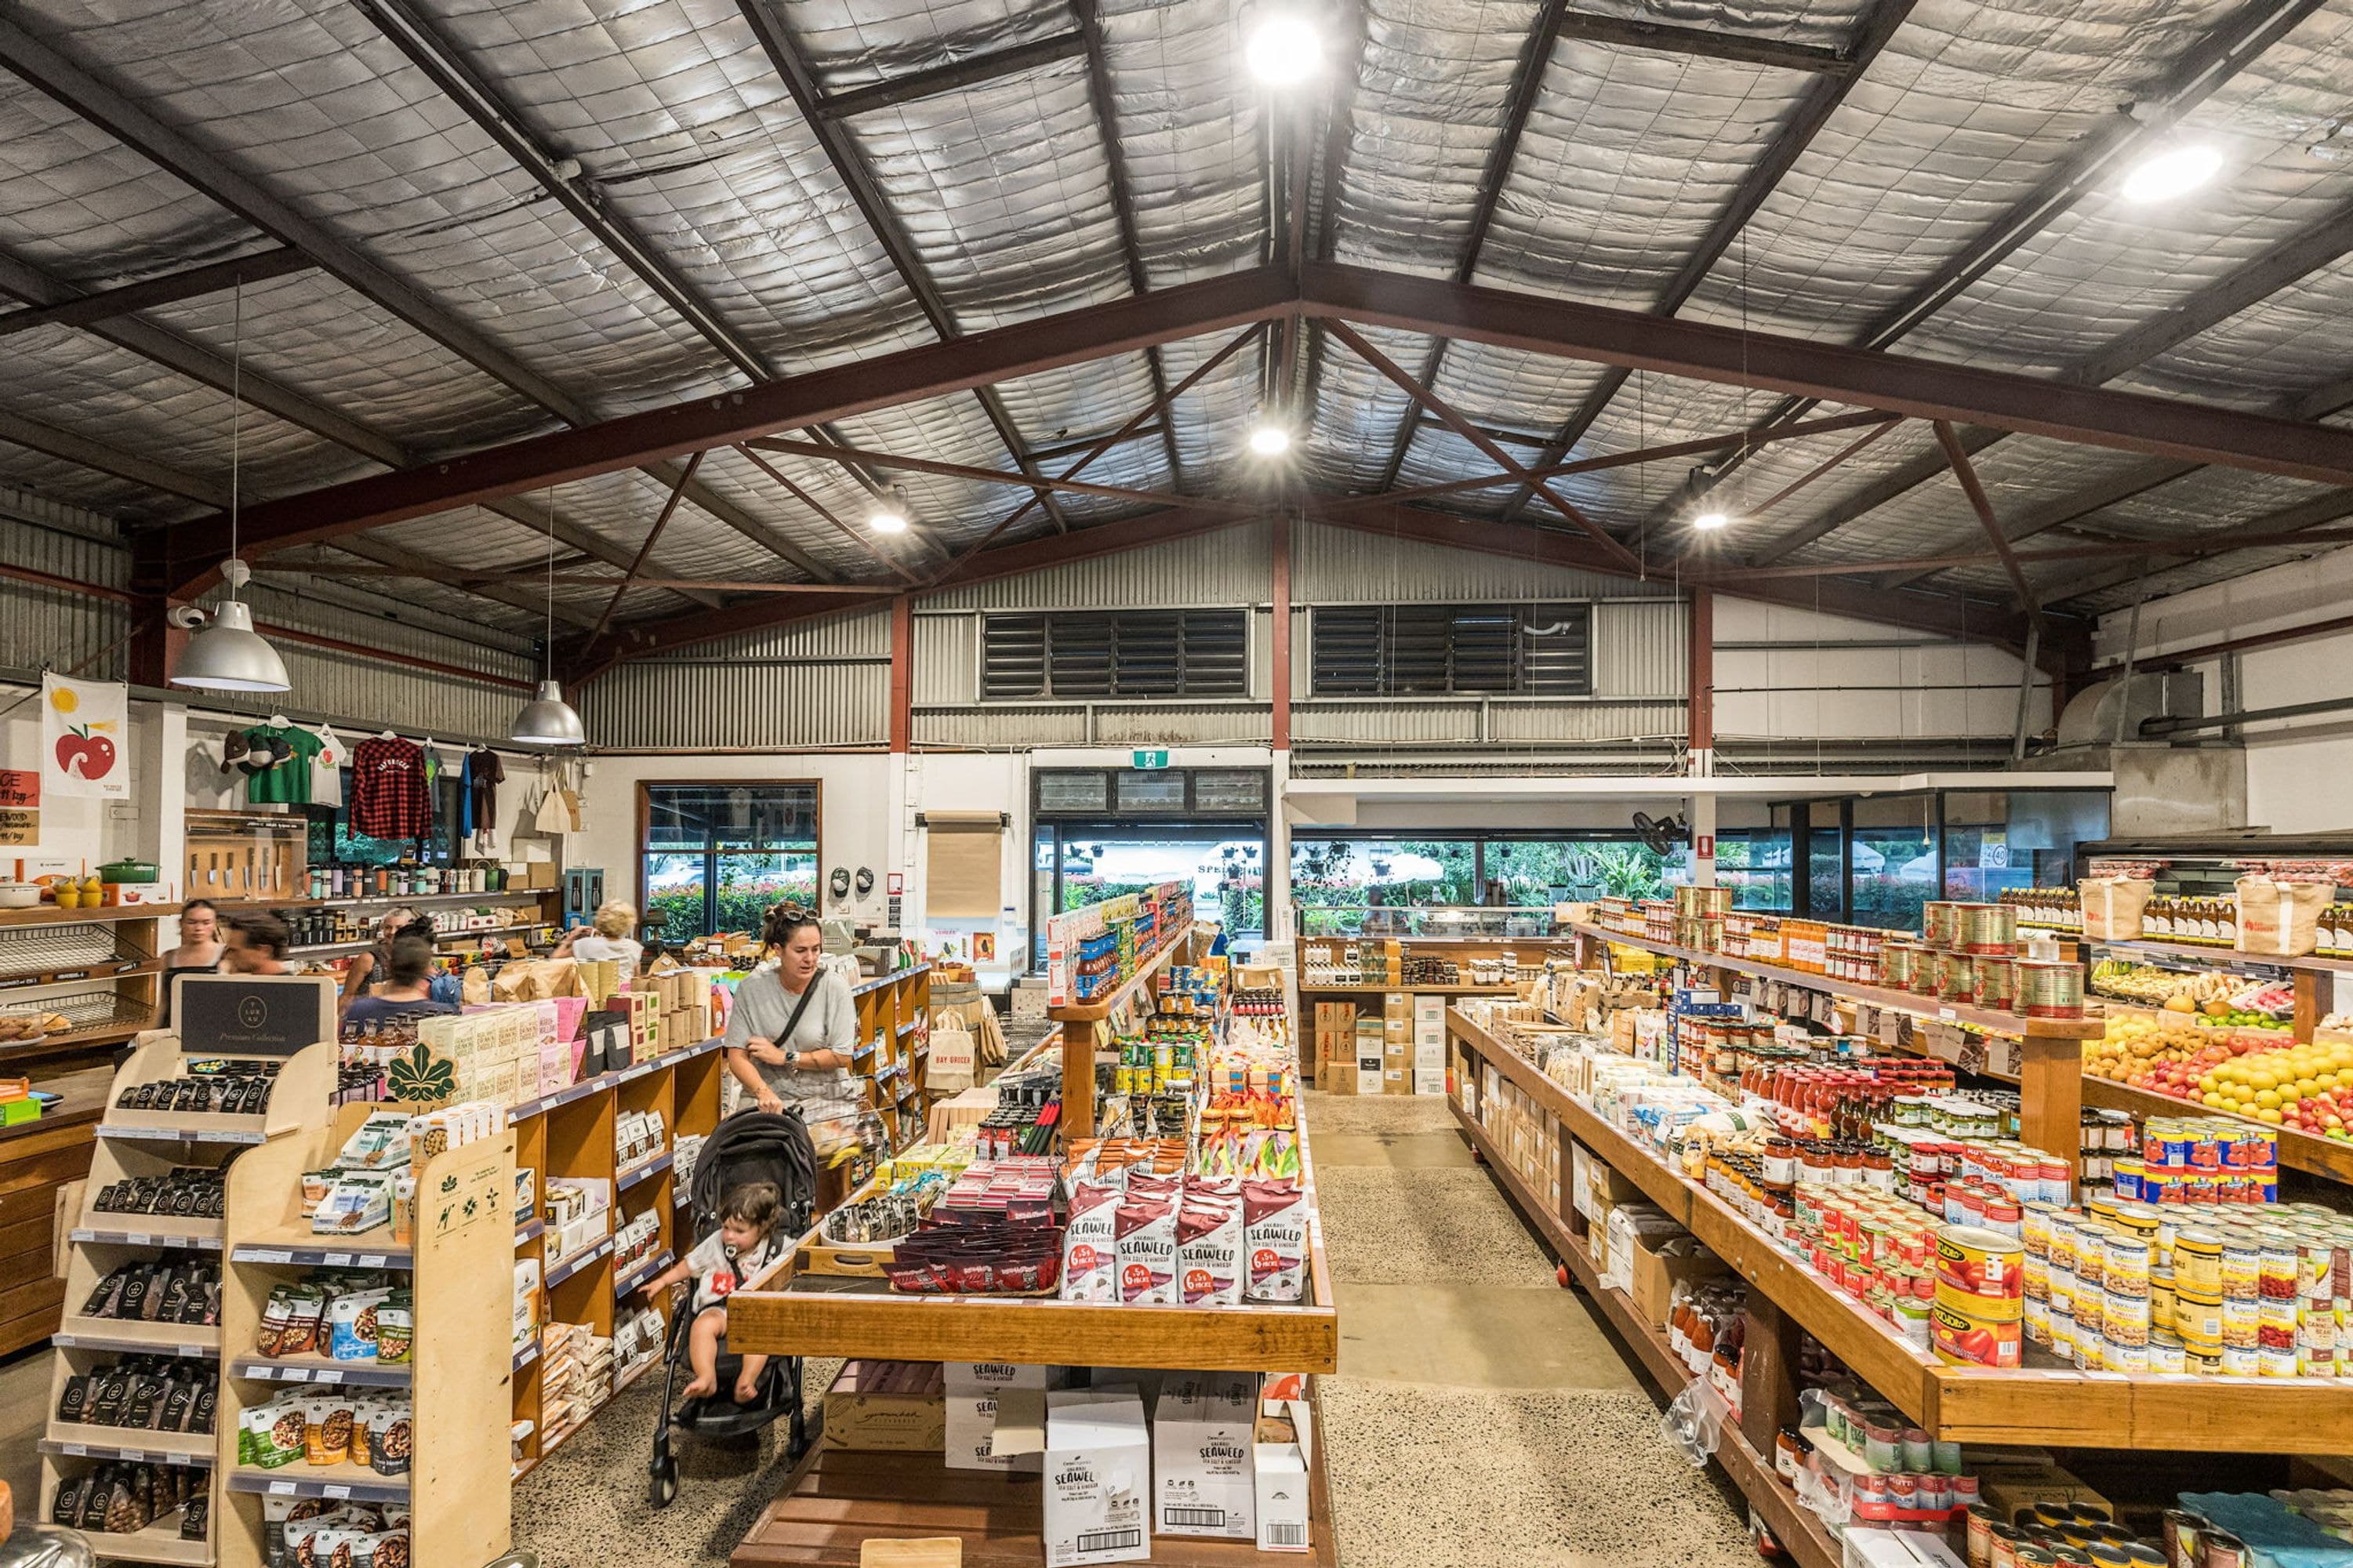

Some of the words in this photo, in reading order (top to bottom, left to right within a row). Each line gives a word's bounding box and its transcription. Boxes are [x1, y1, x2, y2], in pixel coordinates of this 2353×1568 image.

[1995, 851, 2005, 860] 40
[1984, 1154, 2003, 1164] MUTT
[1070, 1222, 1113, 1236] SEAWEE
[1251, 1229, 1302, 1242] SEAWEED
[1120, 1241, 1173, 1256] SEAWEED
[1182, 1248, 1235, 1261] SEAWEED
[1071, 1251, 1079, 1266] 6
[1254, 1255, 1262, 1269] 6
[1124, 1270, 1134, 1285] 6
[1186, 1275, 1194, 1290] 6
[973, 1364, 1015, 1376] SEAWEED
[1200, 1446, 1244, 1458] SEAWEED
